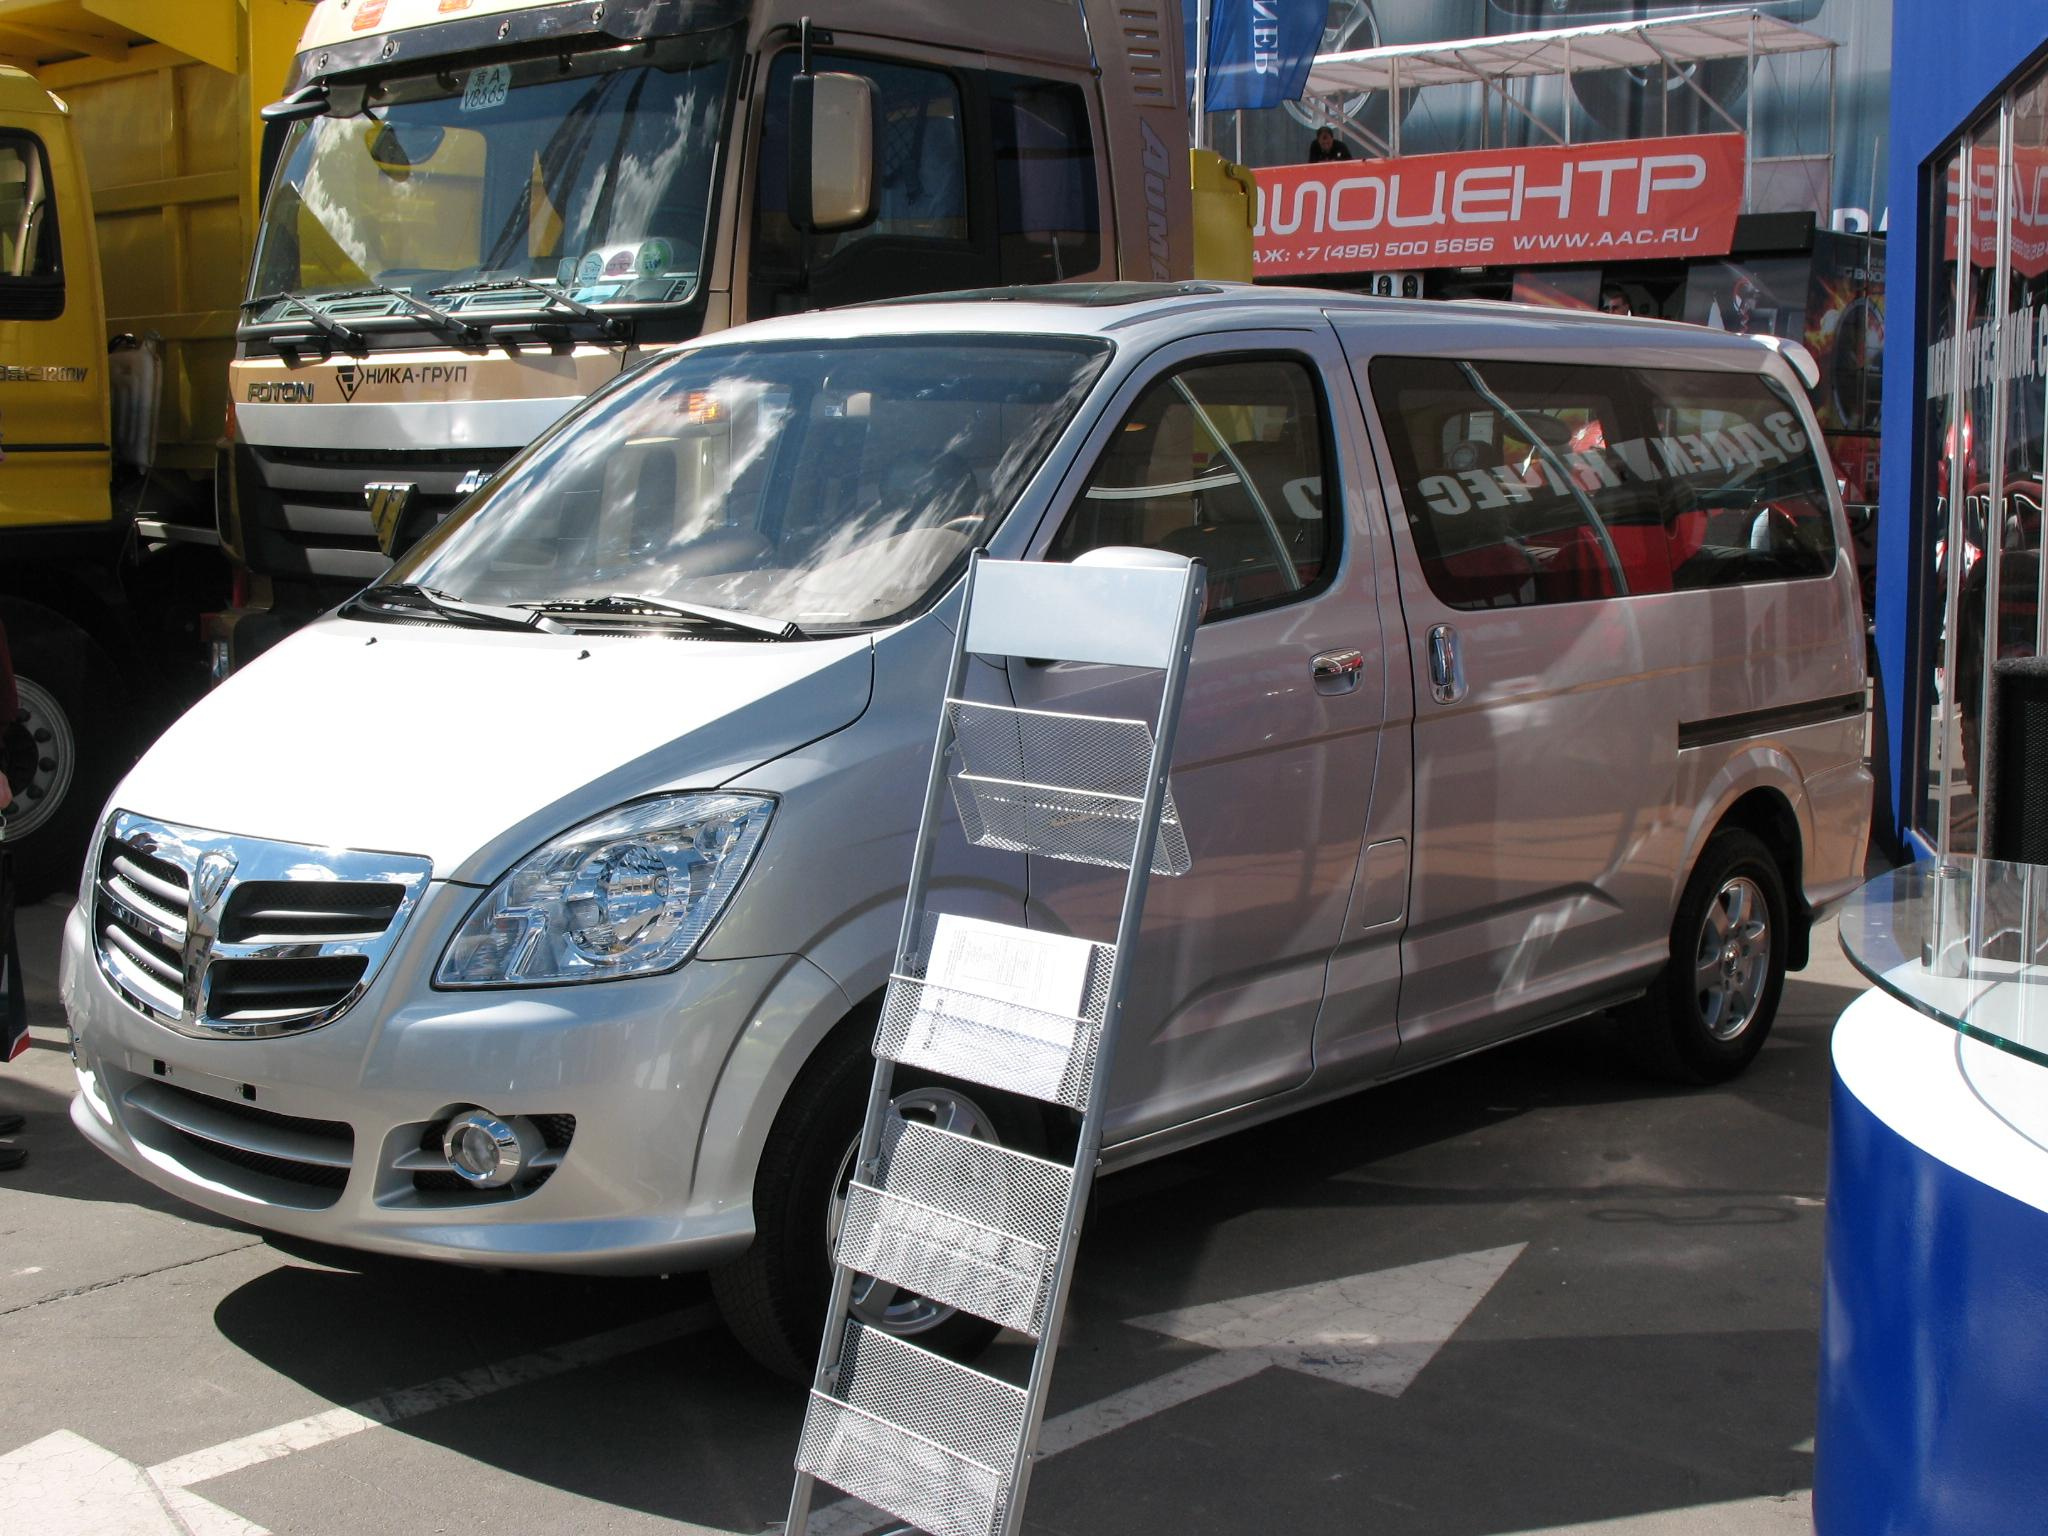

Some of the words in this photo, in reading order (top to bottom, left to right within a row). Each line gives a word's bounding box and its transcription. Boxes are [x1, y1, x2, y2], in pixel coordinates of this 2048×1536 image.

[1253, 153, 1707, 237] ИОЦЕНТР
[1297, 246, 1320, 262] +7
[1324, 242, 1379, 261] (495)
[1385, 240, 1428, 257] 500
[1434, 237, 1495, 254] 5656
[1512, 226, 1700, 251] WWW.AAC.RU
[365, 365, 468, 385] НИКА-ГРУП
[247, 381, 315, 403] FOTON
